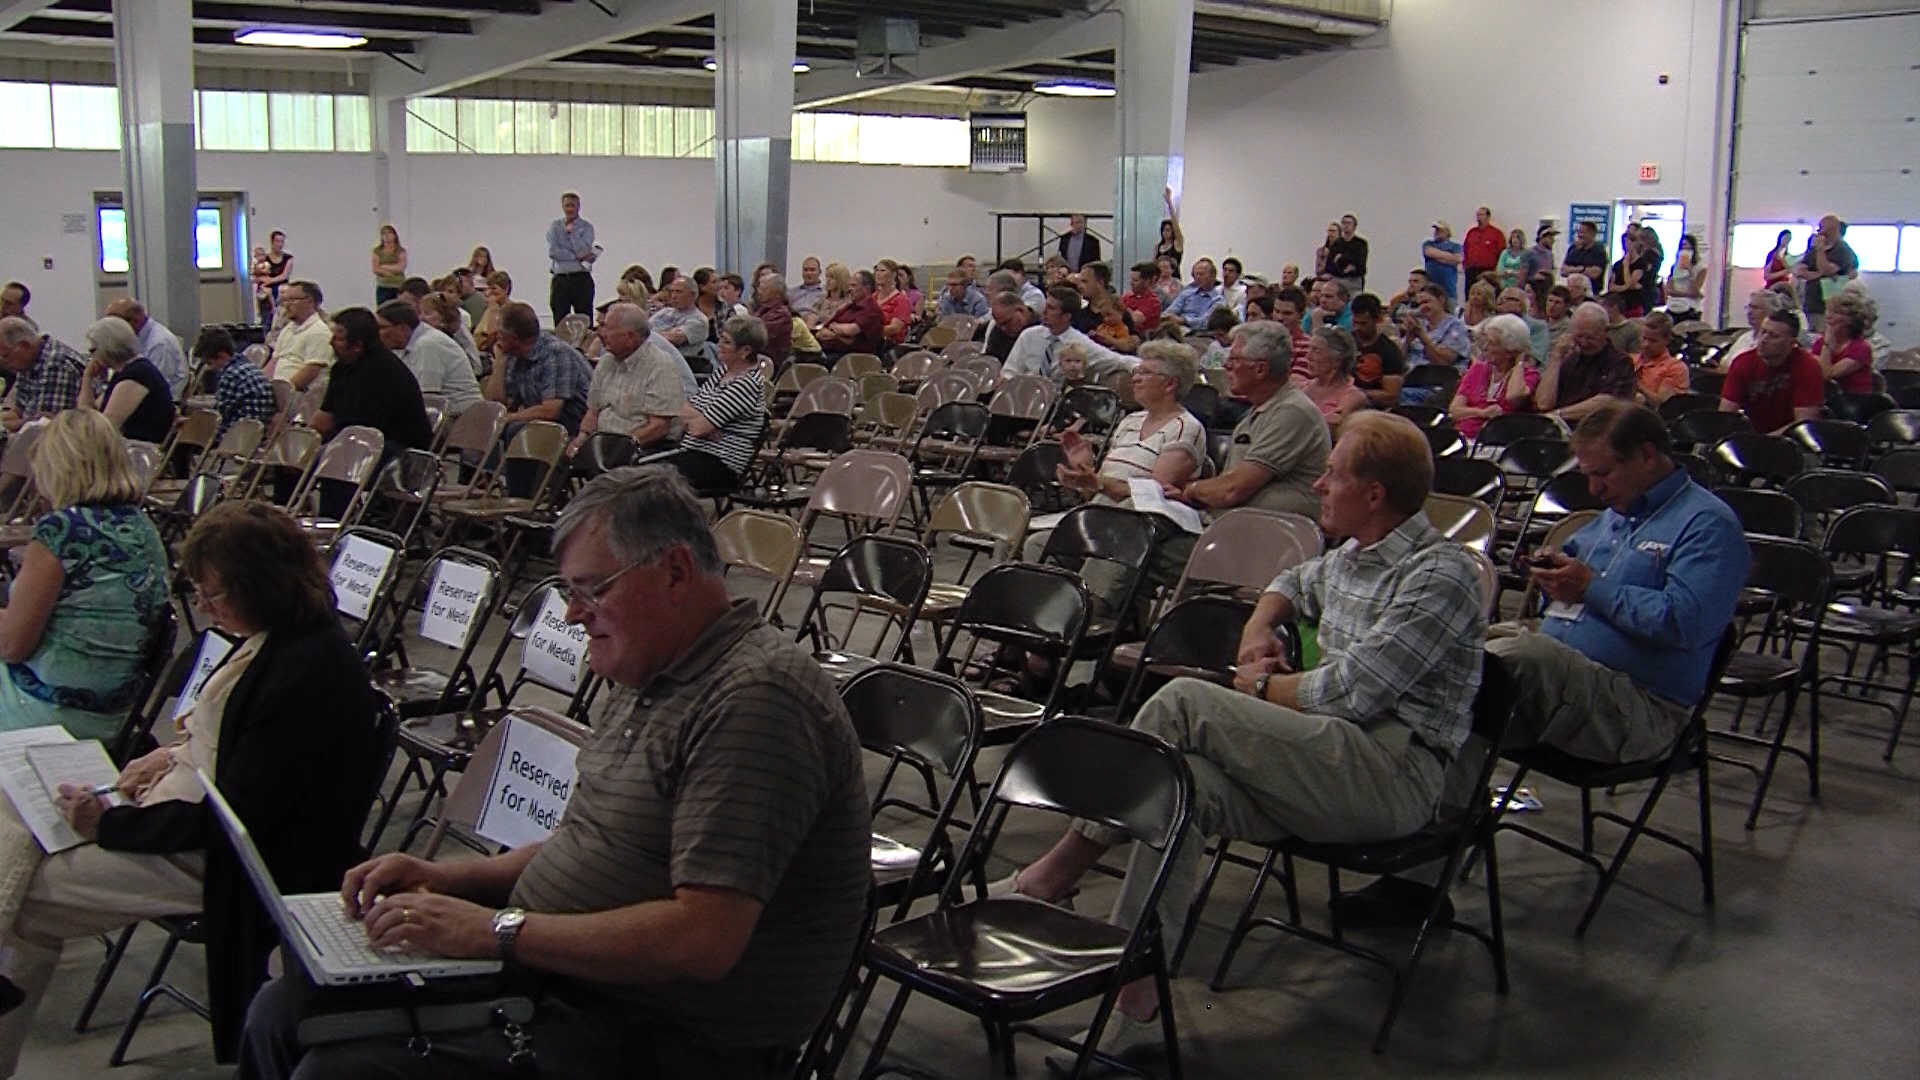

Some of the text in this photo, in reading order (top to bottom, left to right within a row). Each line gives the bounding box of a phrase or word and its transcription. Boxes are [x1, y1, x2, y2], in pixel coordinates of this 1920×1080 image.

[1641, 166, 1656, 178] EXIT
[342, 553, 382, 578] Reserved
[334, 571, 371, 598] for Media
[438, 580, 480, 604] Reserved
[431, 601, 470, 625] for Media
[542, 610, 585, 642] Reserved
[532, 631, 576, 666] for Media
[509, 751, 570, 801] Reserved
[500, 784, 526, 812] for
